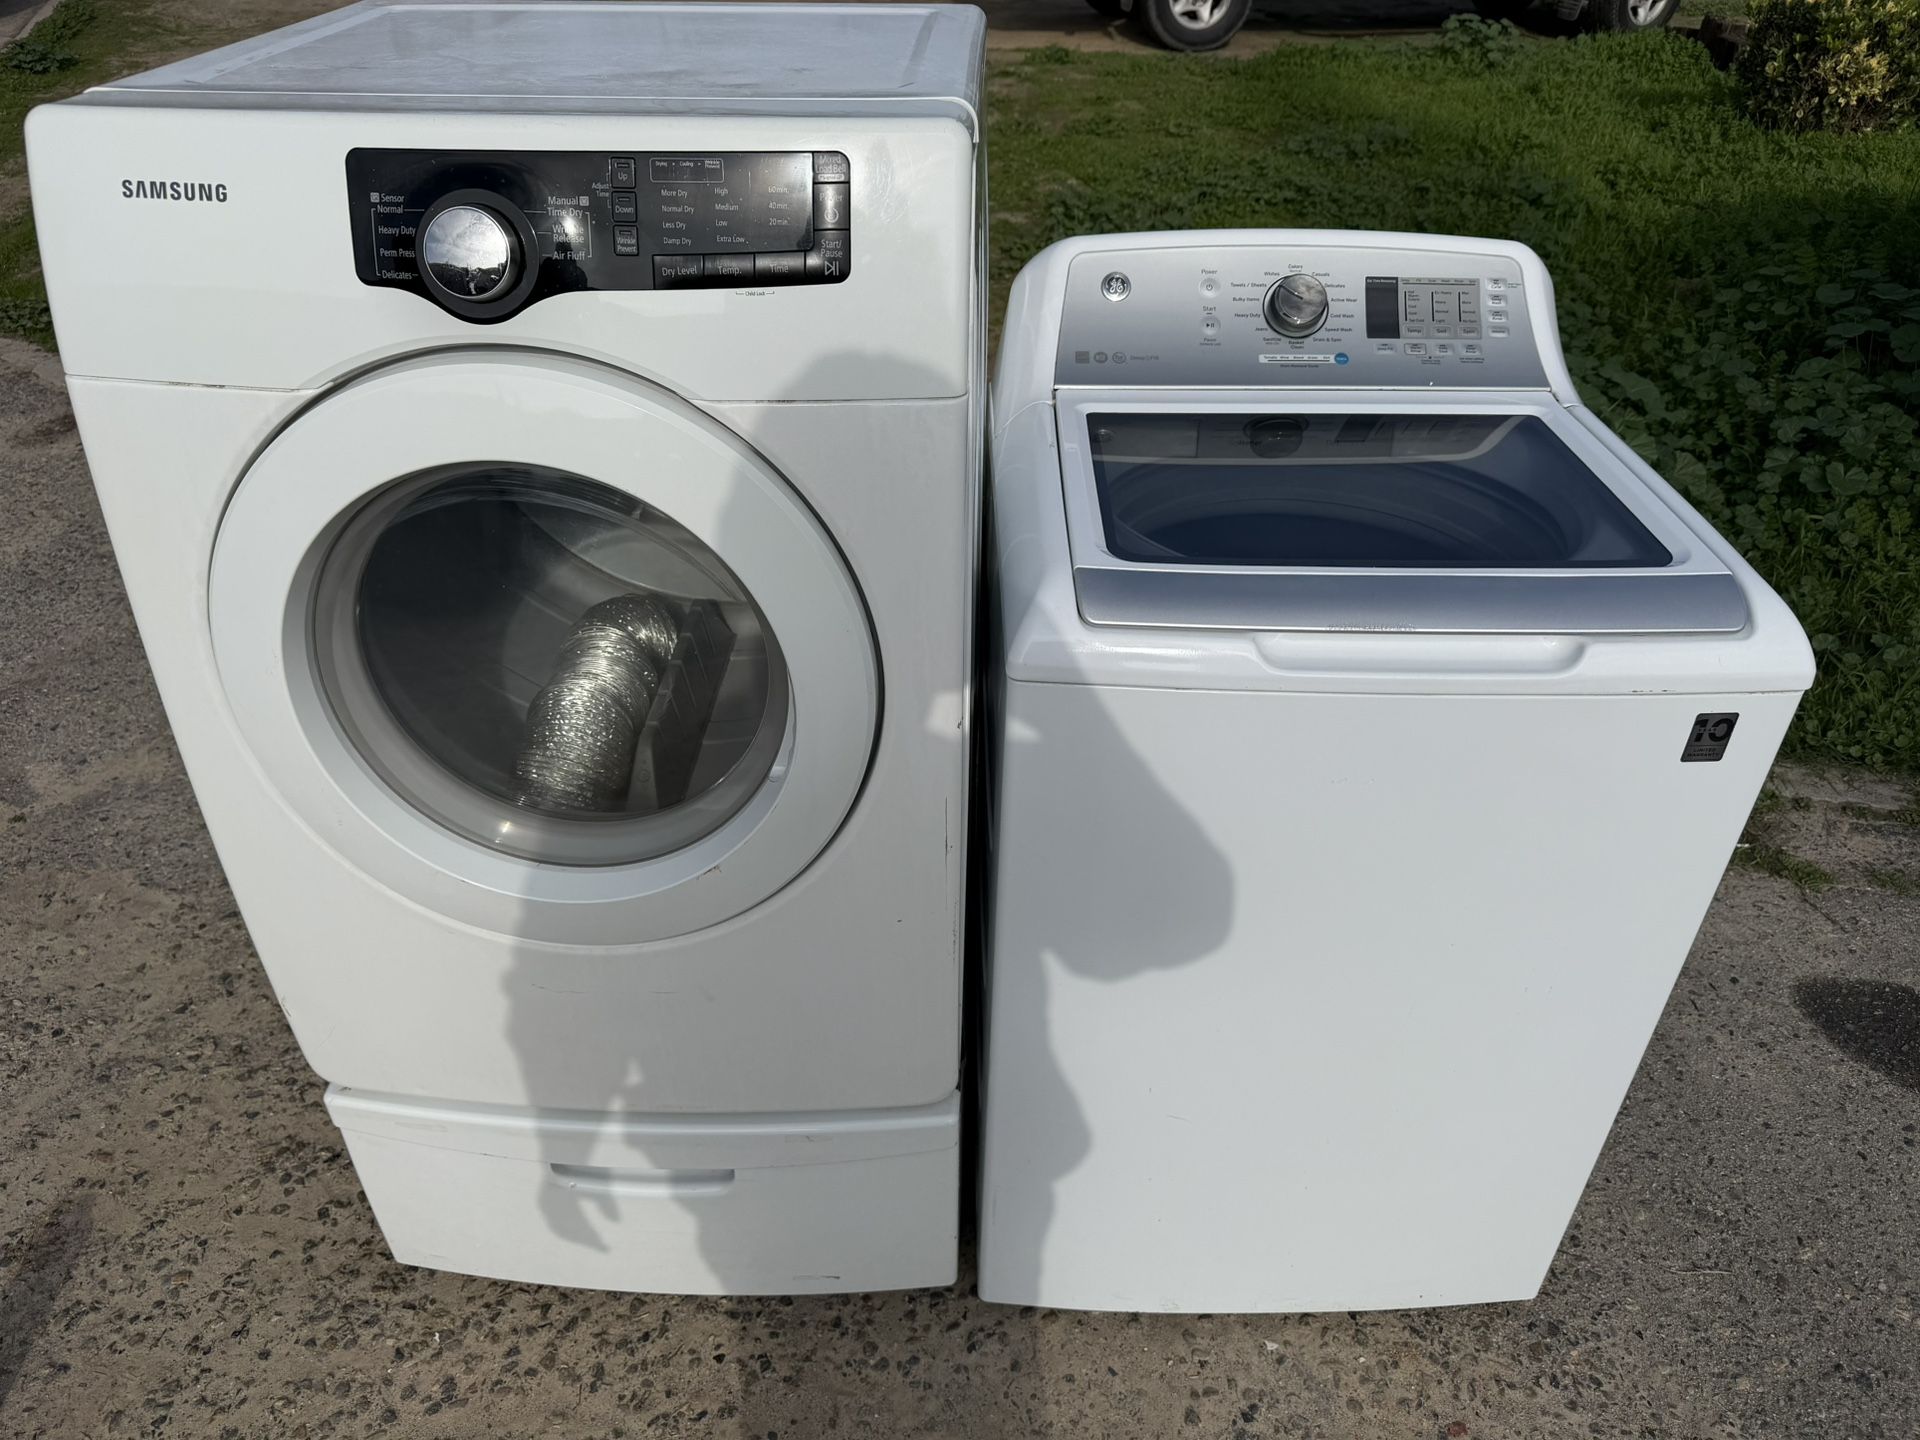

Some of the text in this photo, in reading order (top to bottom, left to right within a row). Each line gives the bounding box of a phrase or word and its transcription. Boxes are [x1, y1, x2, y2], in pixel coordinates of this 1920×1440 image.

[815, 164, 847, 174] Load Bell
[617, 172, 629, 182] Up
[121, 179, 228, 203] SAMSUNG
[591, 182, 610, 190] Adjust
[596, 190, 610, 198] Time
[661, 189, 688, 199] More Dry
[714, 187, 729, 197] High
[380, 192, 405, 203] Sensor
[548, 195, 579, 206] Manual
[377, 204, 404, 214] Normal
[547, 206, 584, 219] Time Dry
[615, 205, 634, 214] Down
[661, 204, 695, 215] Normal Dry
[714, 203, 739, 212] Medium
[662, 221, 686, 231] Less Dry
[715, 219, 728, 227] Low
[378, 226, 416, 237] Heavy Duty
[553, 233, 585, 243] Release
[617, 237, 637, 245] Wrinkle
[663, 236, 692, 247] Damp Dry
[716, 234, 745, 243] Extra Low
[820, 239, 842, 249] Start/
[380, 248, 415, 259] Perm Press
[617, 245, 637, 254] Prevent
[820, 249, 843, 258] Pause
[552, 250, 585, 261] Air Fluff
[662, 265, 697, 277] Dry Level
[718, 266, 742, 277] Temp.
[769, 263, 789, 273] Time
[382, 269, 412, 280] Delicates
[1694, 718, 1734, 742] 10
